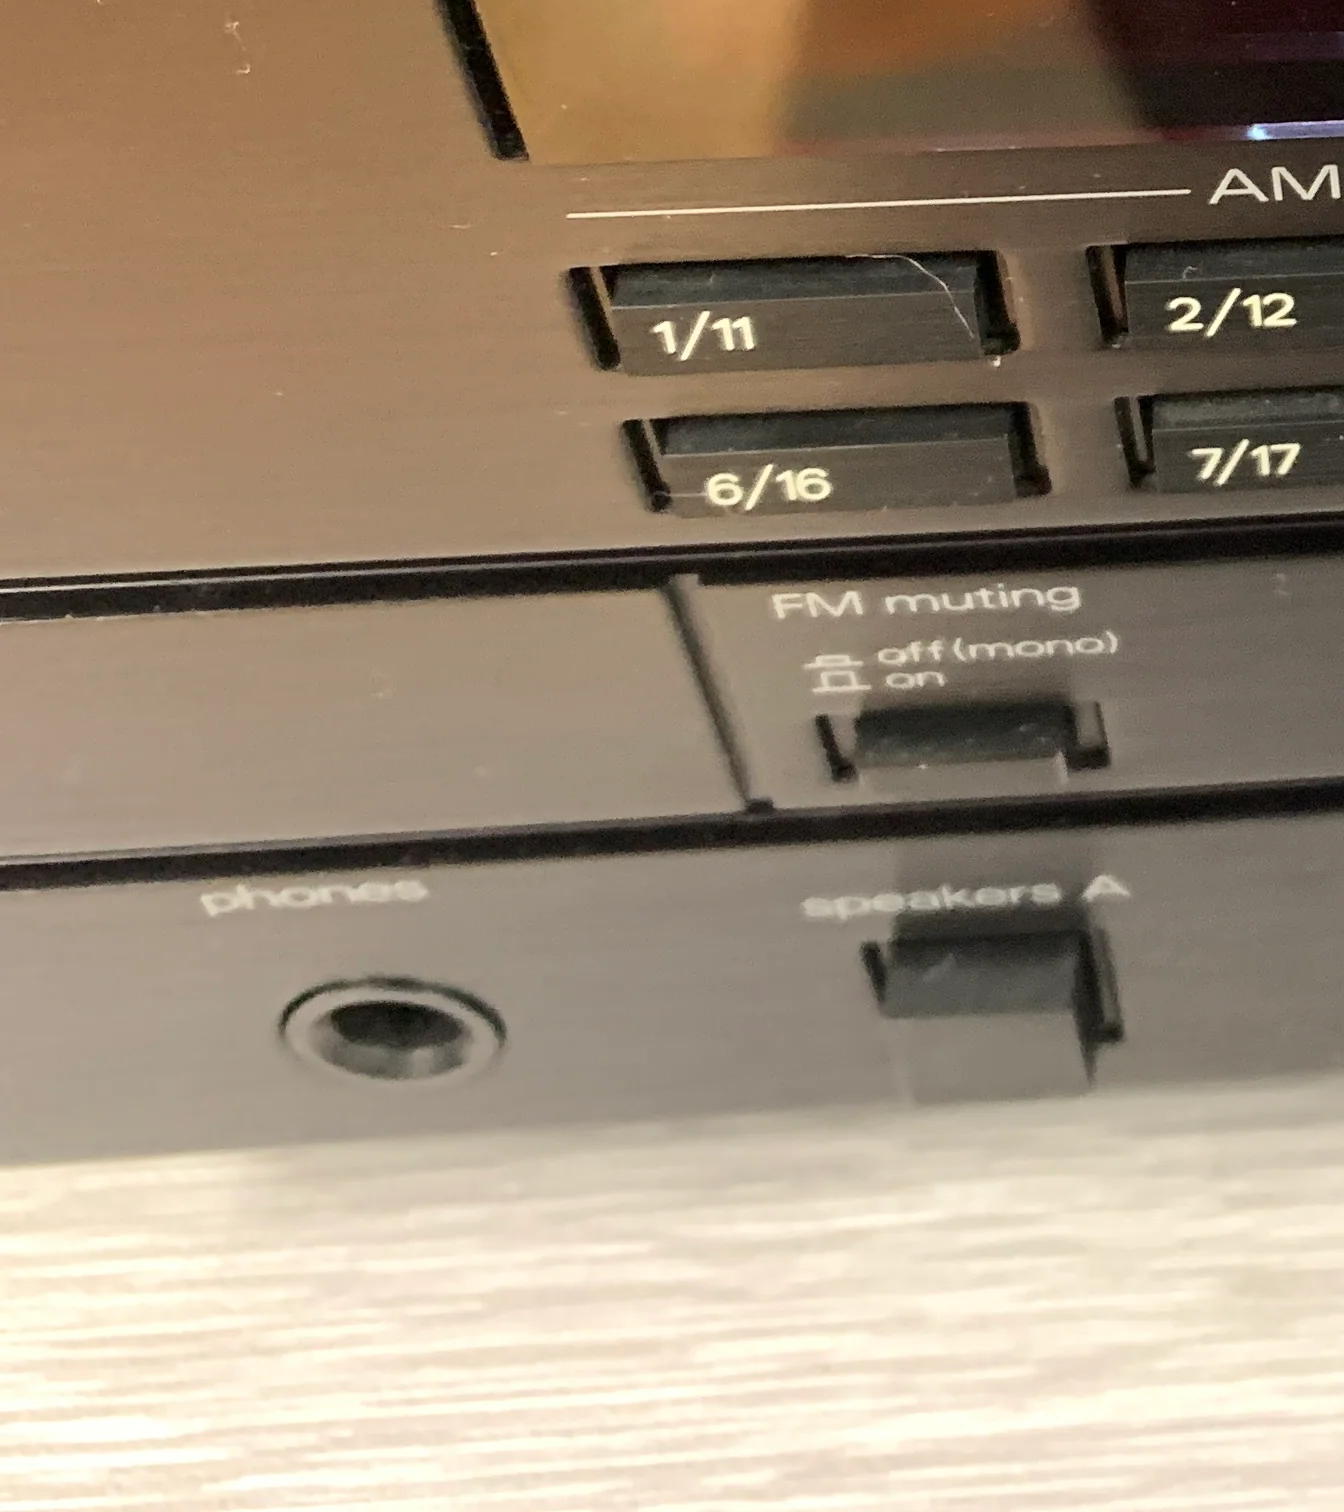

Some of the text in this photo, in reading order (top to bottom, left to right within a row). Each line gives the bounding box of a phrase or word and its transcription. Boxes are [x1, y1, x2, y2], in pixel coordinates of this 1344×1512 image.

[1165, 286, 1297, 338] 2/12
[652, 311, 757, 362] 1/11
[1190, 438, 1302, 486] 7/17
[705, 463, 834, 512] 6/16
[771, 581, 1082, 619] FM muting
[885, 667, 946, 690] on
[201, 877, 430, 918] phones
[804, 874, 1131, 920] speakers A
